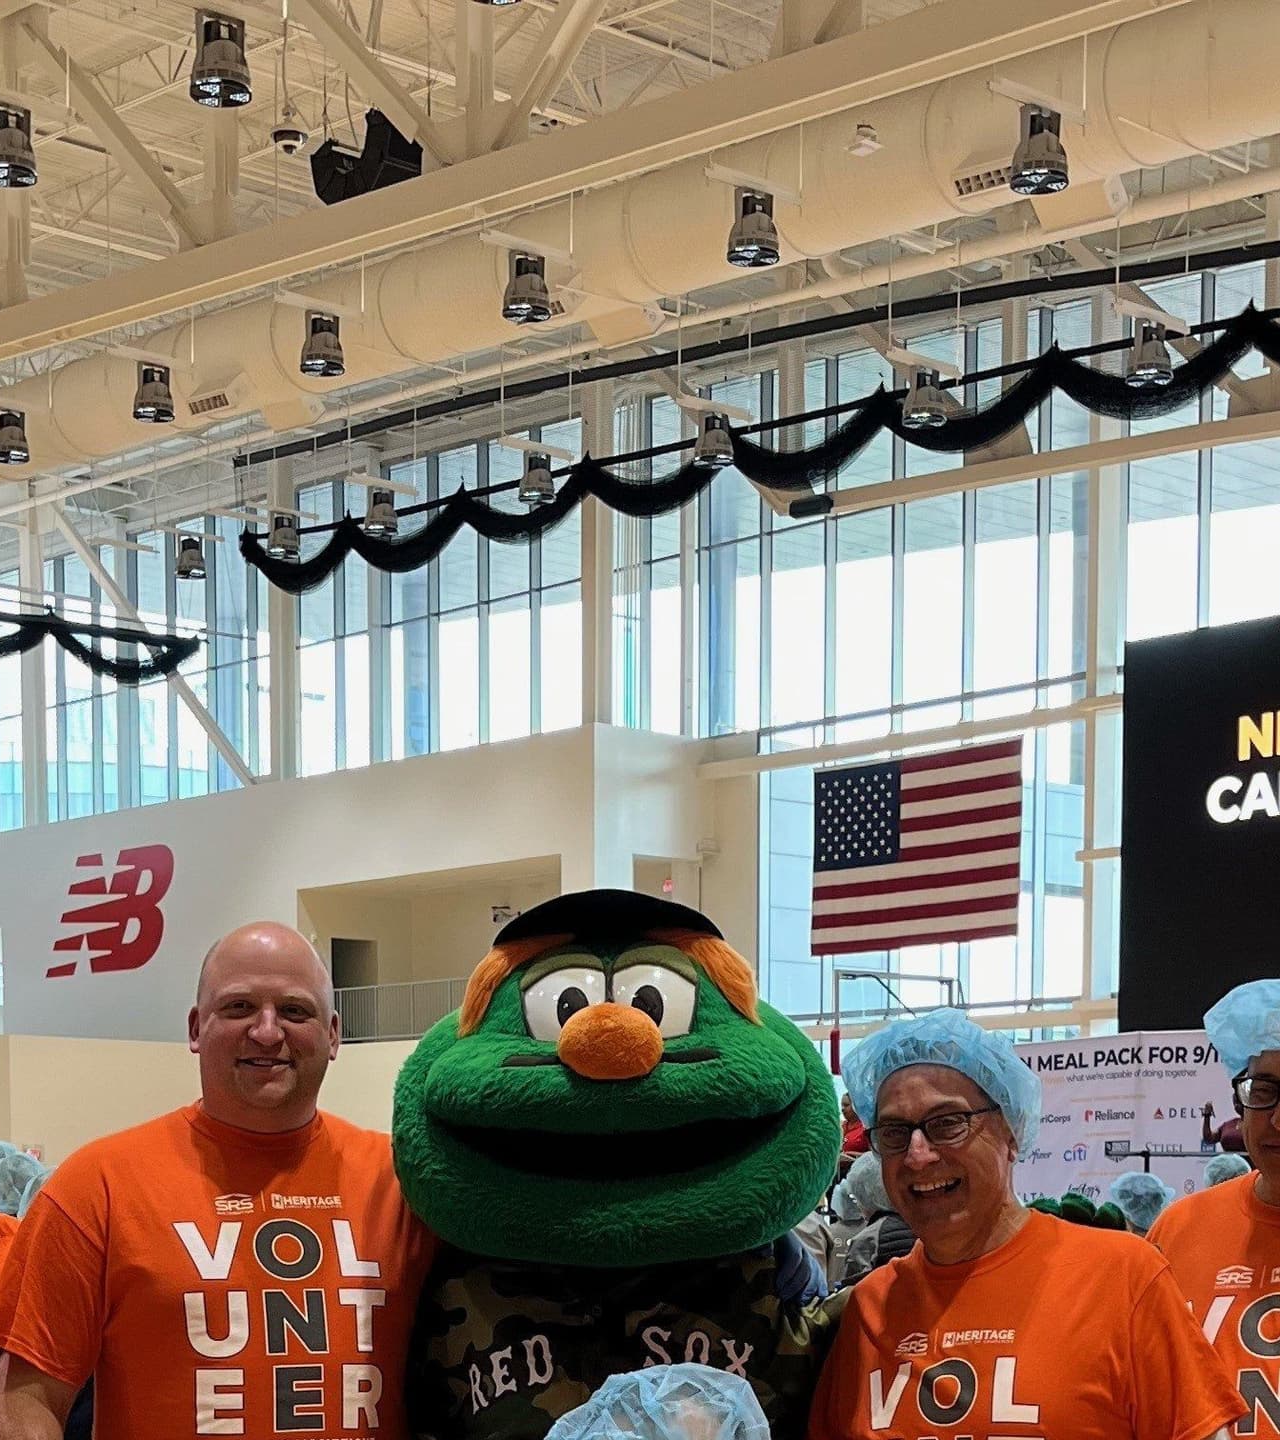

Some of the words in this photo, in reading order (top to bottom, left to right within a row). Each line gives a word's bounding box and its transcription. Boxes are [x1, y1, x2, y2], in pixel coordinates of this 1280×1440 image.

[1038, 1053, 1088, 1072] MEAL
[1094, 1047, 1143, 1068] PACK
[1149, 1047, 1187, 1064] FOR
[1095, 1109, 1135, 1121] Reliance
[1064, 1147, 1087, 1162] citi
[215, 1200, 253, 1213] SRS
[284, 1195, 342, 1208] HERITAGE
[172, 1217, 381, 1282] VOL
[1215, 1274, 1254, 1285] SRS
[184, 1288, 386, 1358] UNT
[955, 1330, 1015, 1345] HERITAGE
[469, 1334, 554, 1415] RED
[641, 1326, 754, 1378] SOX
[196, 1364, 383, 1435] EER
[870, 1357, 1040, 1431] VOL
